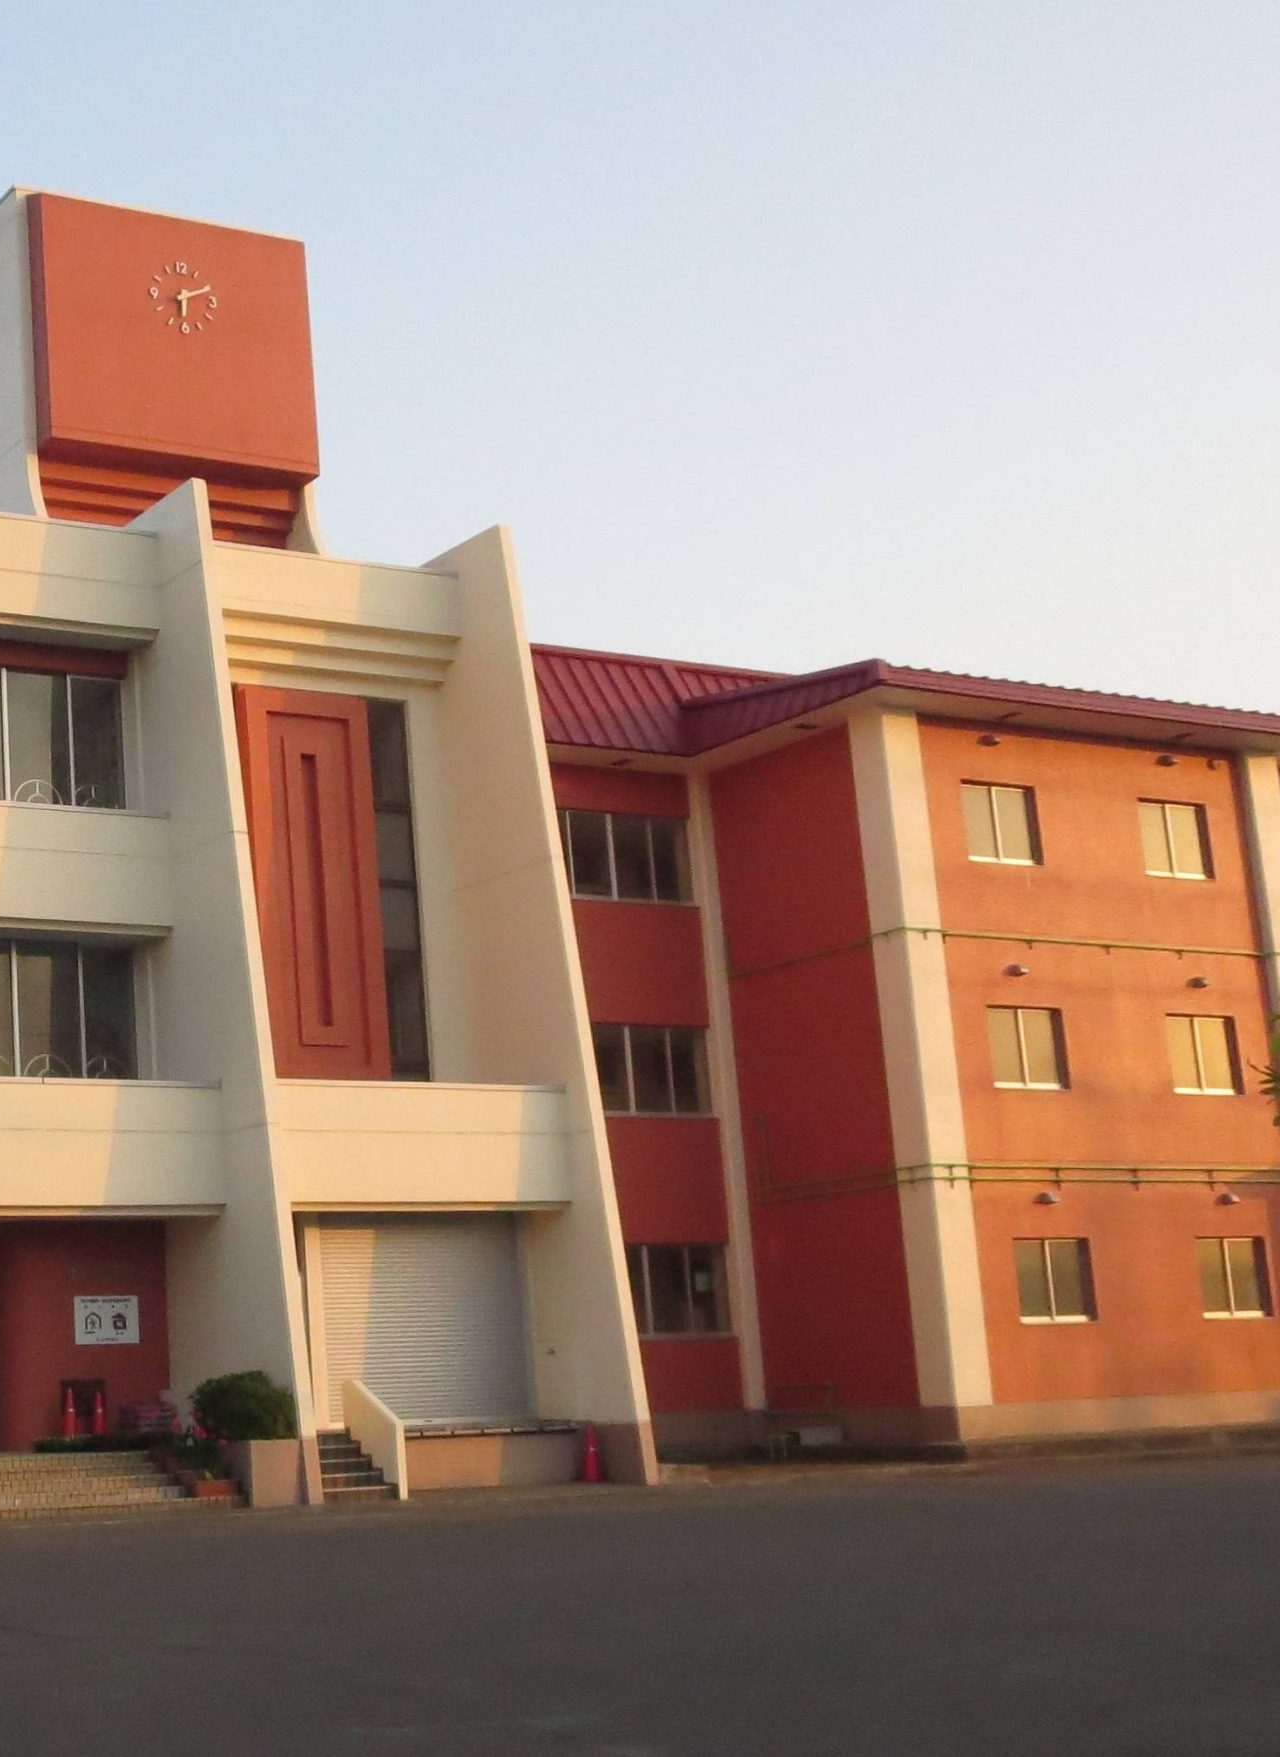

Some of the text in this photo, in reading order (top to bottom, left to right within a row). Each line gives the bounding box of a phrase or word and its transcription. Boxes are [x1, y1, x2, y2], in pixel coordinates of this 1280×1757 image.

[176, 261, 188, 275] 12
[149, 287, 159, 299] 9
[208, 296, 217, 308] 3
[181, 322, 190, 334] 6
